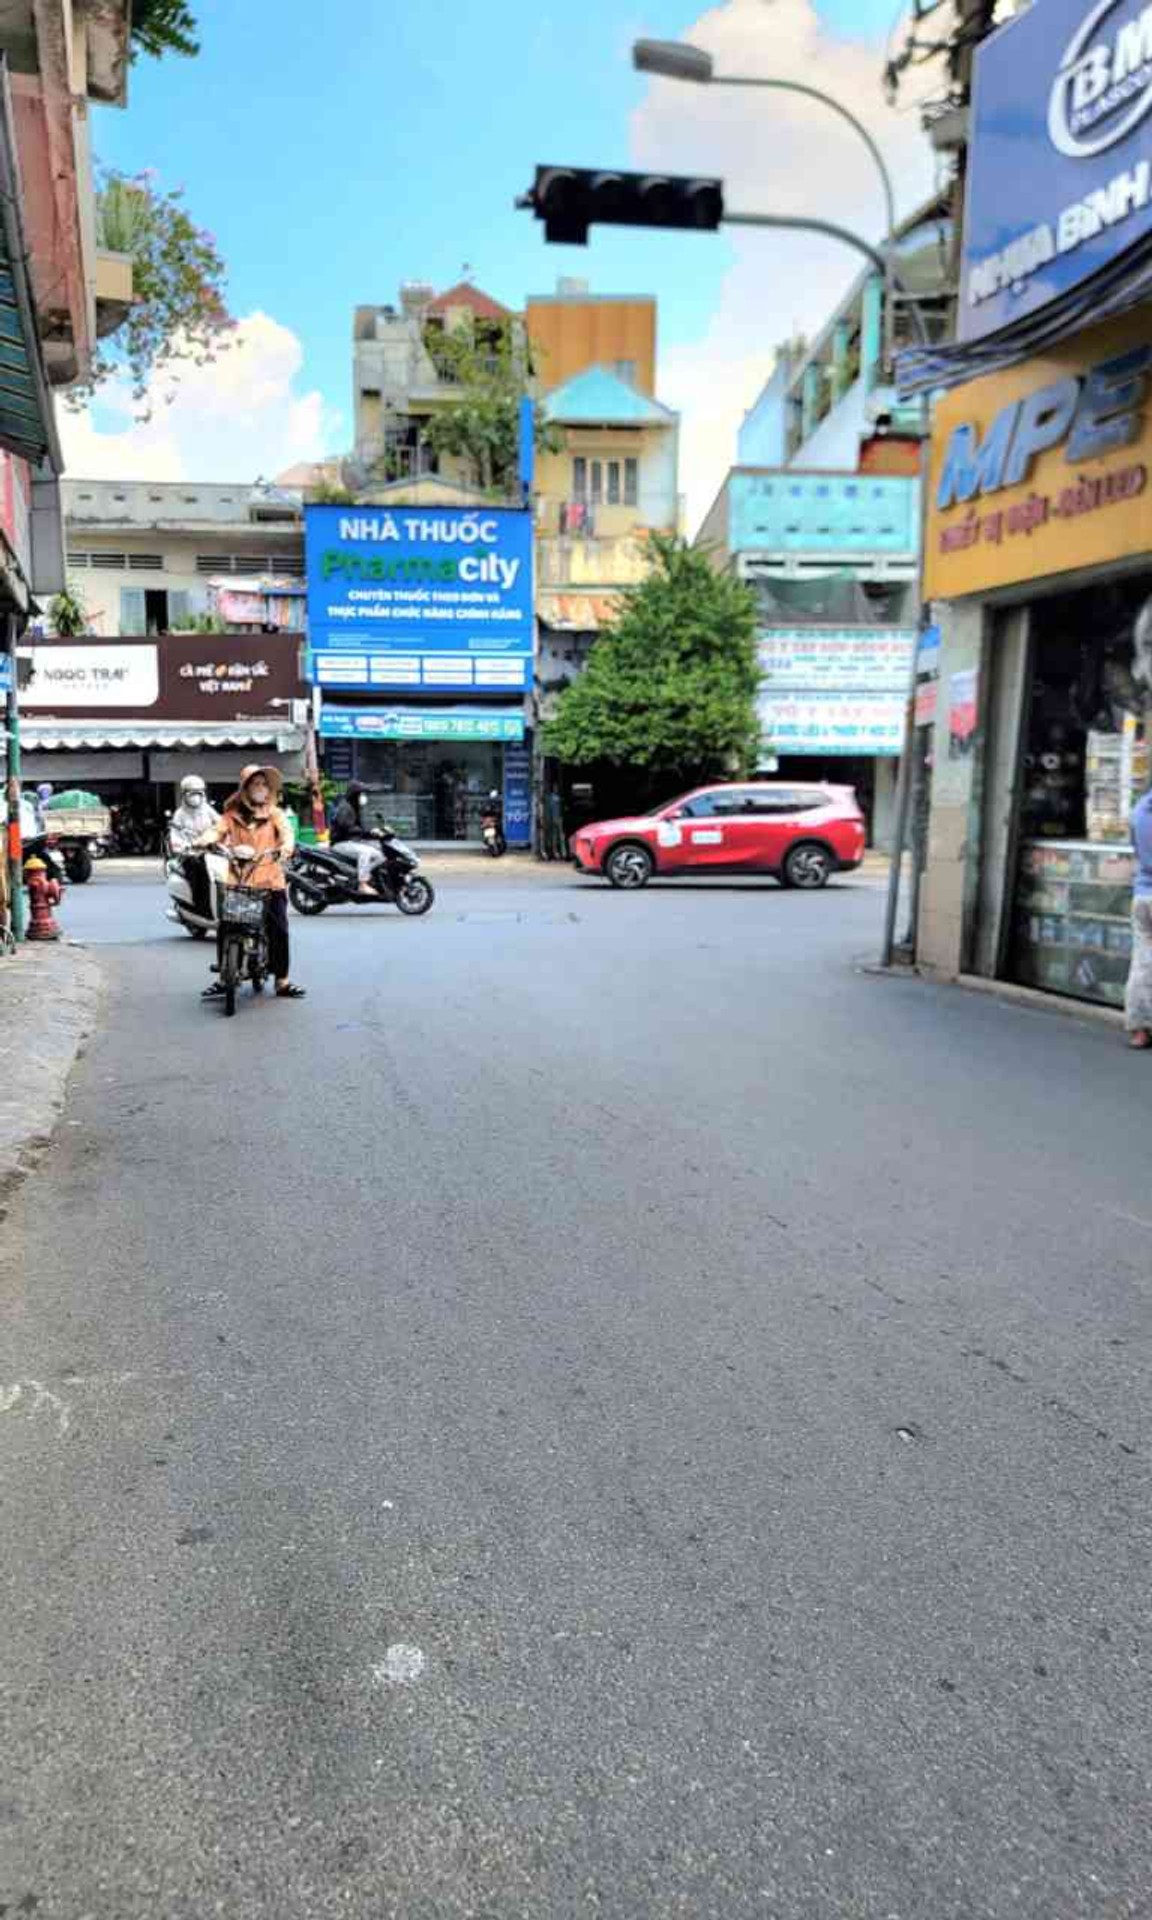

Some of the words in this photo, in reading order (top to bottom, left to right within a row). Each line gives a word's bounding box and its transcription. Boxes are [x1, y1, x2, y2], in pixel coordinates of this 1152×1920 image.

[936, 350, 1150, 511] MPE
[339, 513, 399, 541] NHÀ
[404, 512, 498, 543] THUỐC
[323, 547, 520, 589] Pharmacity
